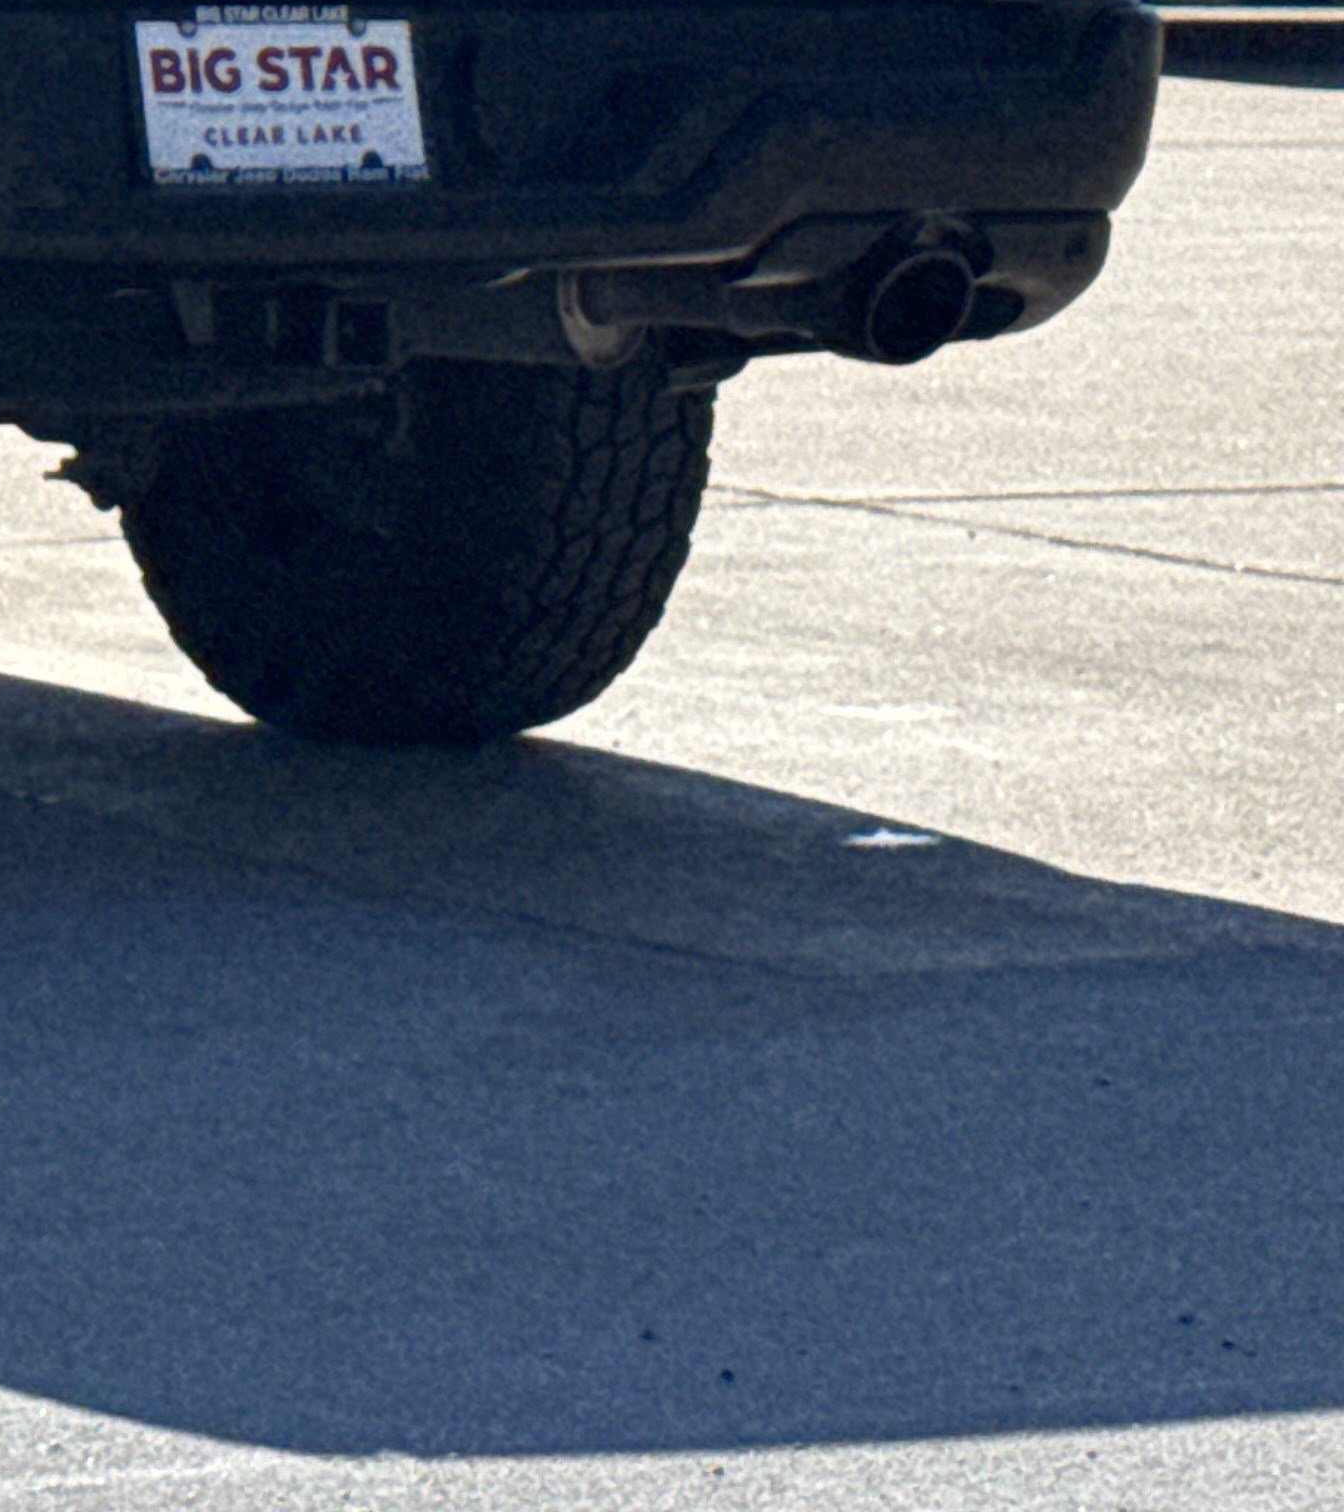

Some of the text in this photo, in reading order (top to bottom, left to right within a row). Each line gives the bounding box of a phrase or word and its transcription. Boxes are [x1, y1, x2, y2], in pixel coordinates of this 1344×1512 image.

[262, 5, 310, 21] CLEAR
[150, 46, 402, 94] BIG STAR
[204, 124, 363, 147] CLEAR LAKE
